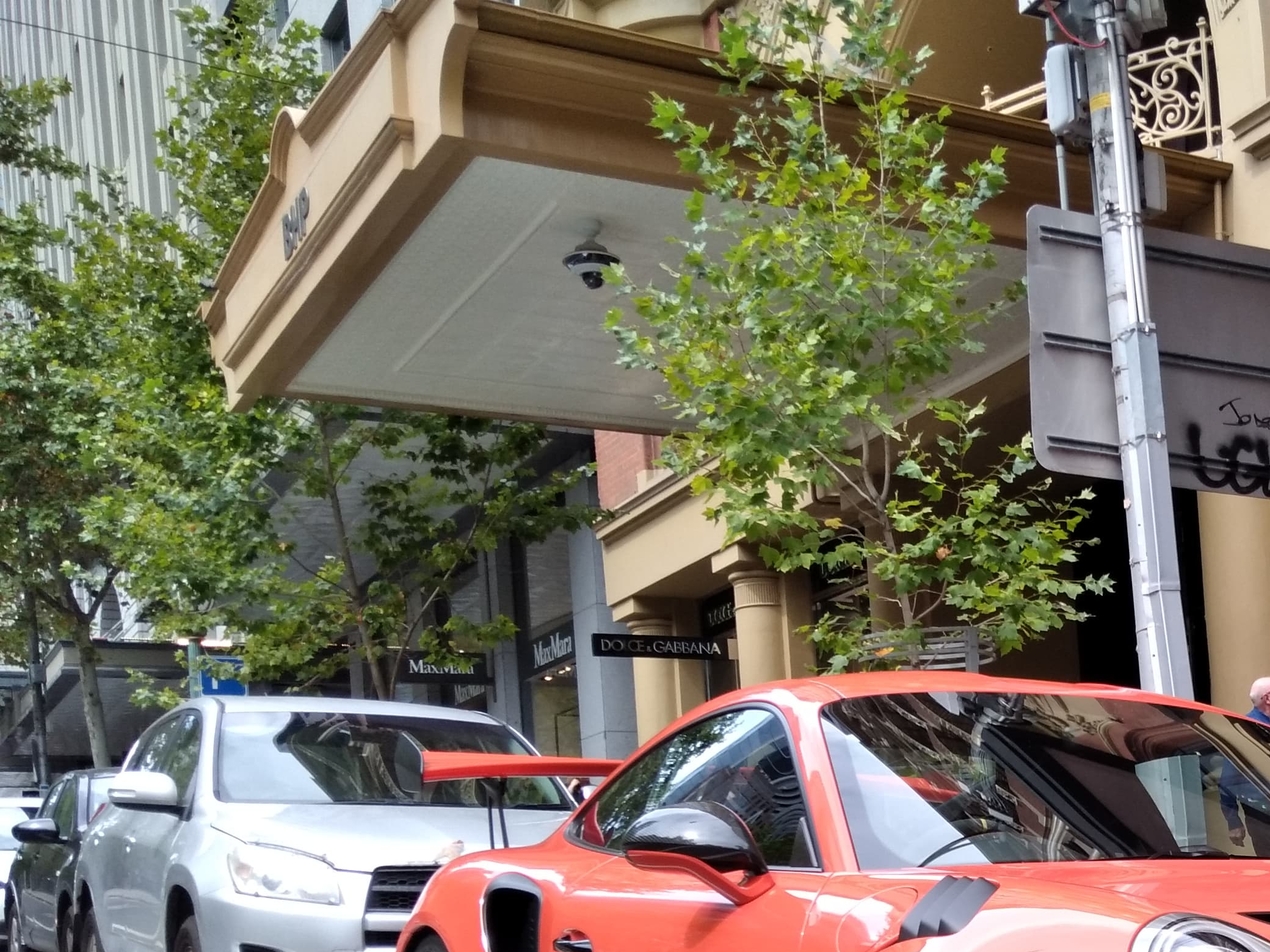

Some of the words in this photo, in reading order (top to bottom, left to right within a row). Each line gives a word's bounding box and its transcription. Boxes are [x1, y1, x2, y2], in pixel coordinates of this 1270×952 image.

[282, 187, 310, 261] BHP
[533, 631, 573, 669] MaxMara
[600, 639, 645, 652] DOCE
[653, 640, 722, 655] GABBANA
[409, 659, 475, 675] MaxMaa
